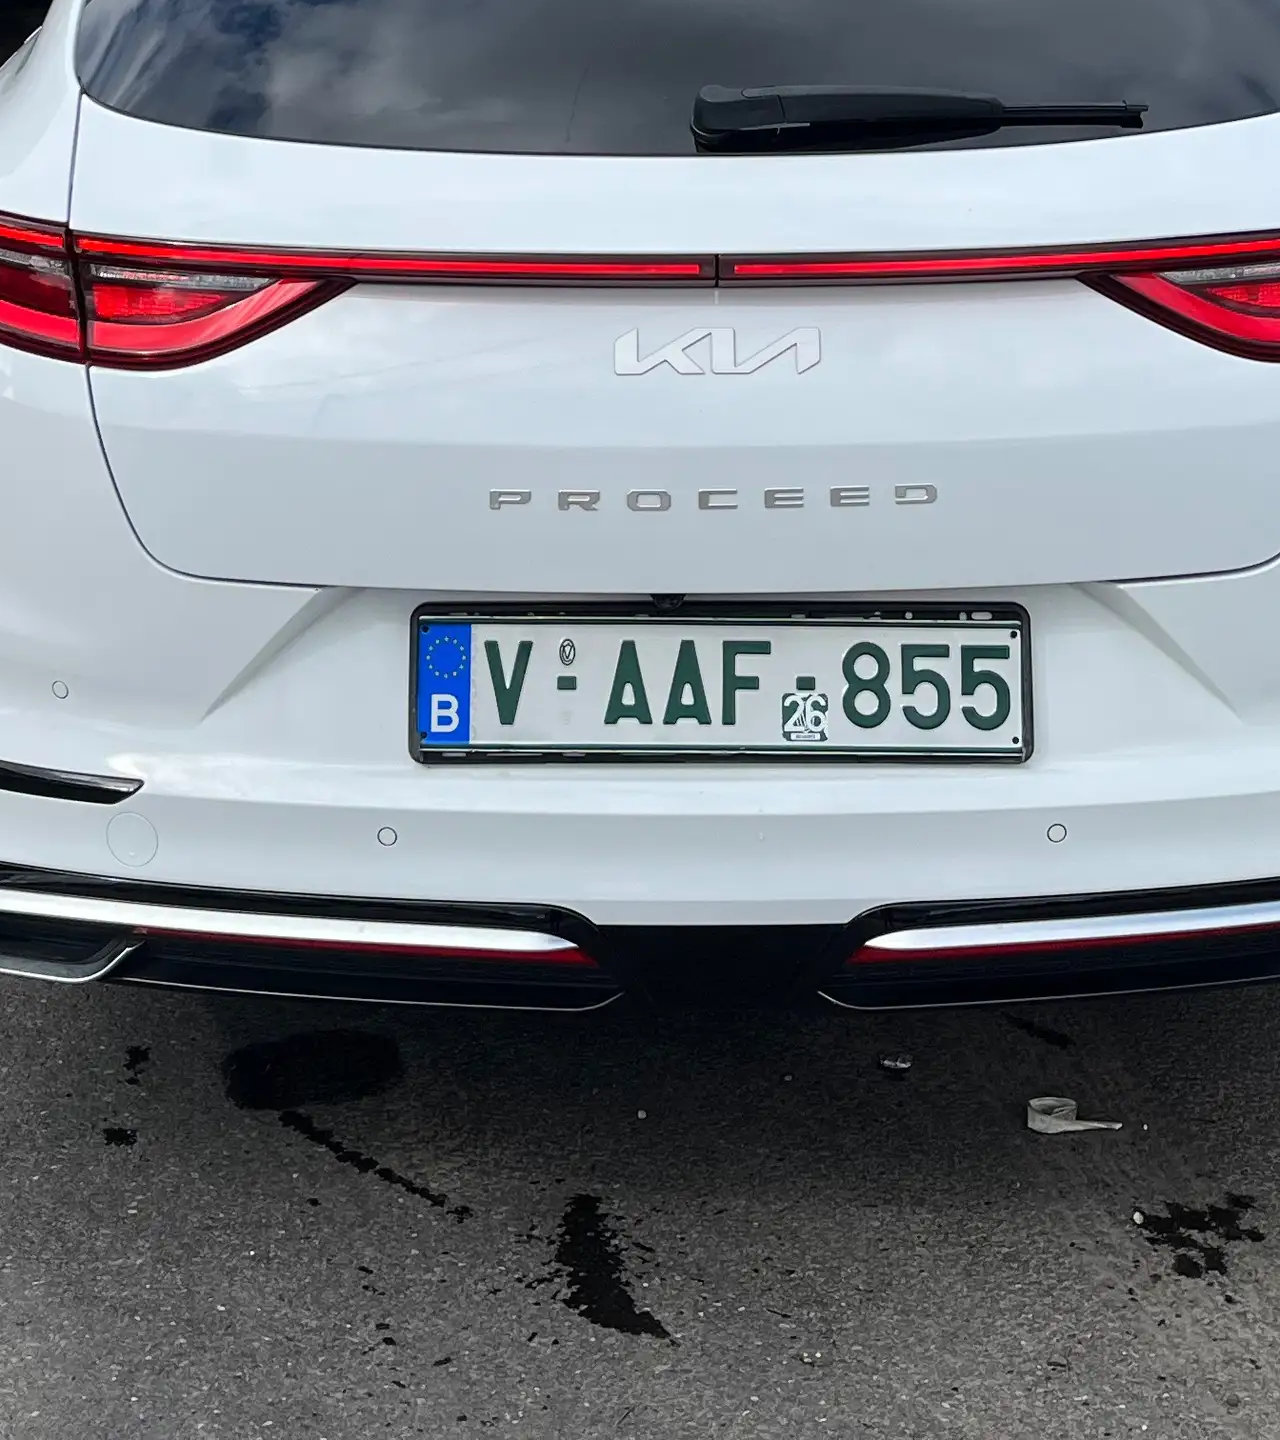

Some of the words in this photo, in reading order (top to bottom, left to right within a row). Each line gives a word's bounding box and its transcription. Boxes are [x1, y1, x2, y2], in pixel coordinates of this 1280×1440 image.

[614, 327, 821, 375] KIA
[489, 483, 937, 511] PROCEED
[430, 695, 459, 732] B
